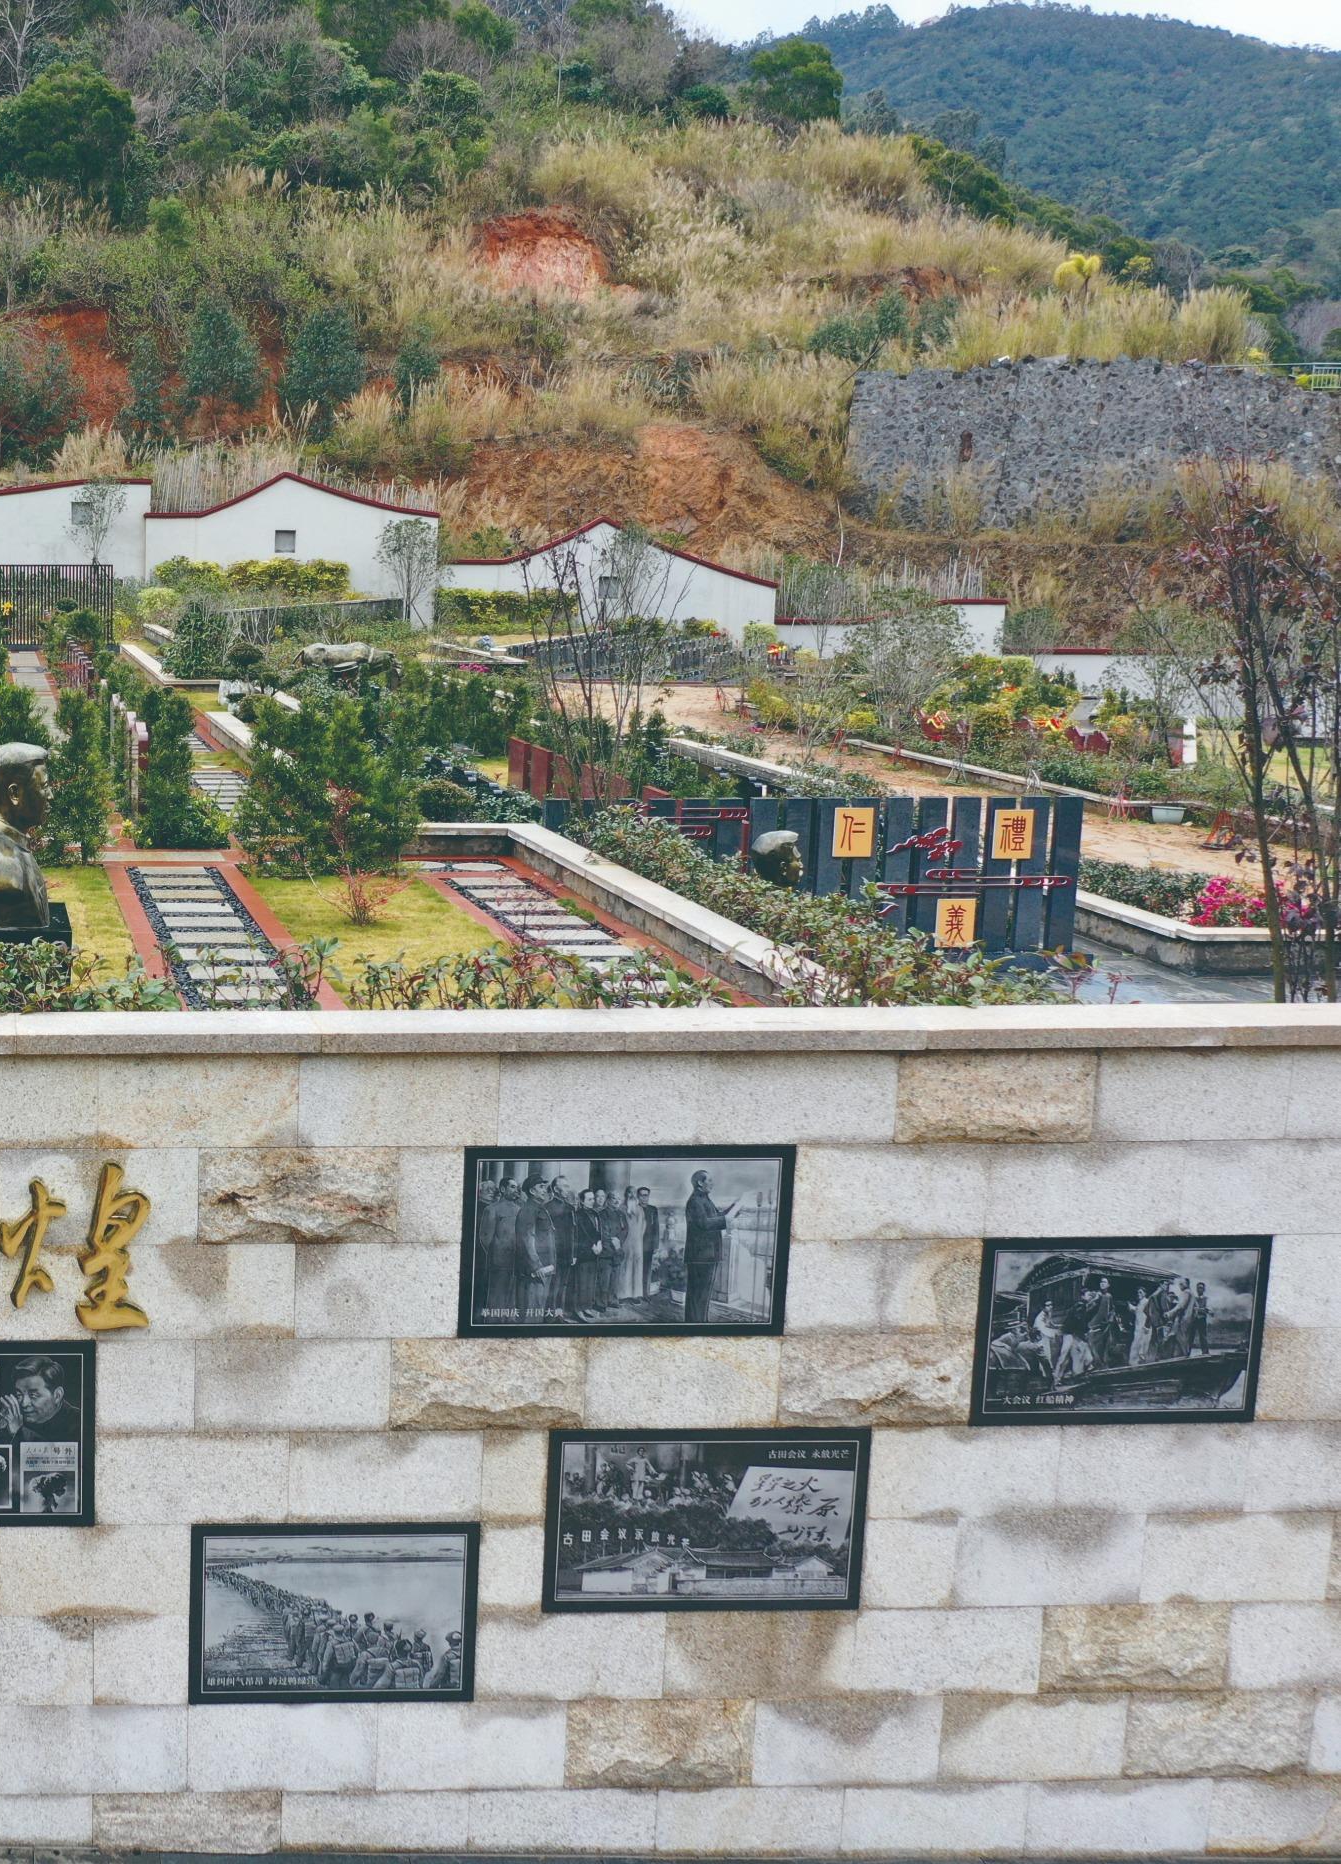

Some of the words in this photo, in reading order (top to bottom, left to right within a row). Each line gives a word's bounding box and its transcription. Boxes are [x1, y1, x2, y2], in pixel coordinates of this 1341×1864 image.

[840, 813, 866, 851] 仁
[481, 1307, 520, 1318] 举国同庆
[525, 1307, 564, 1318] 开国大典
[768, 1449, 807, 1459] 古田会议
[811, 1449, 850, 1459] 永放光芒
